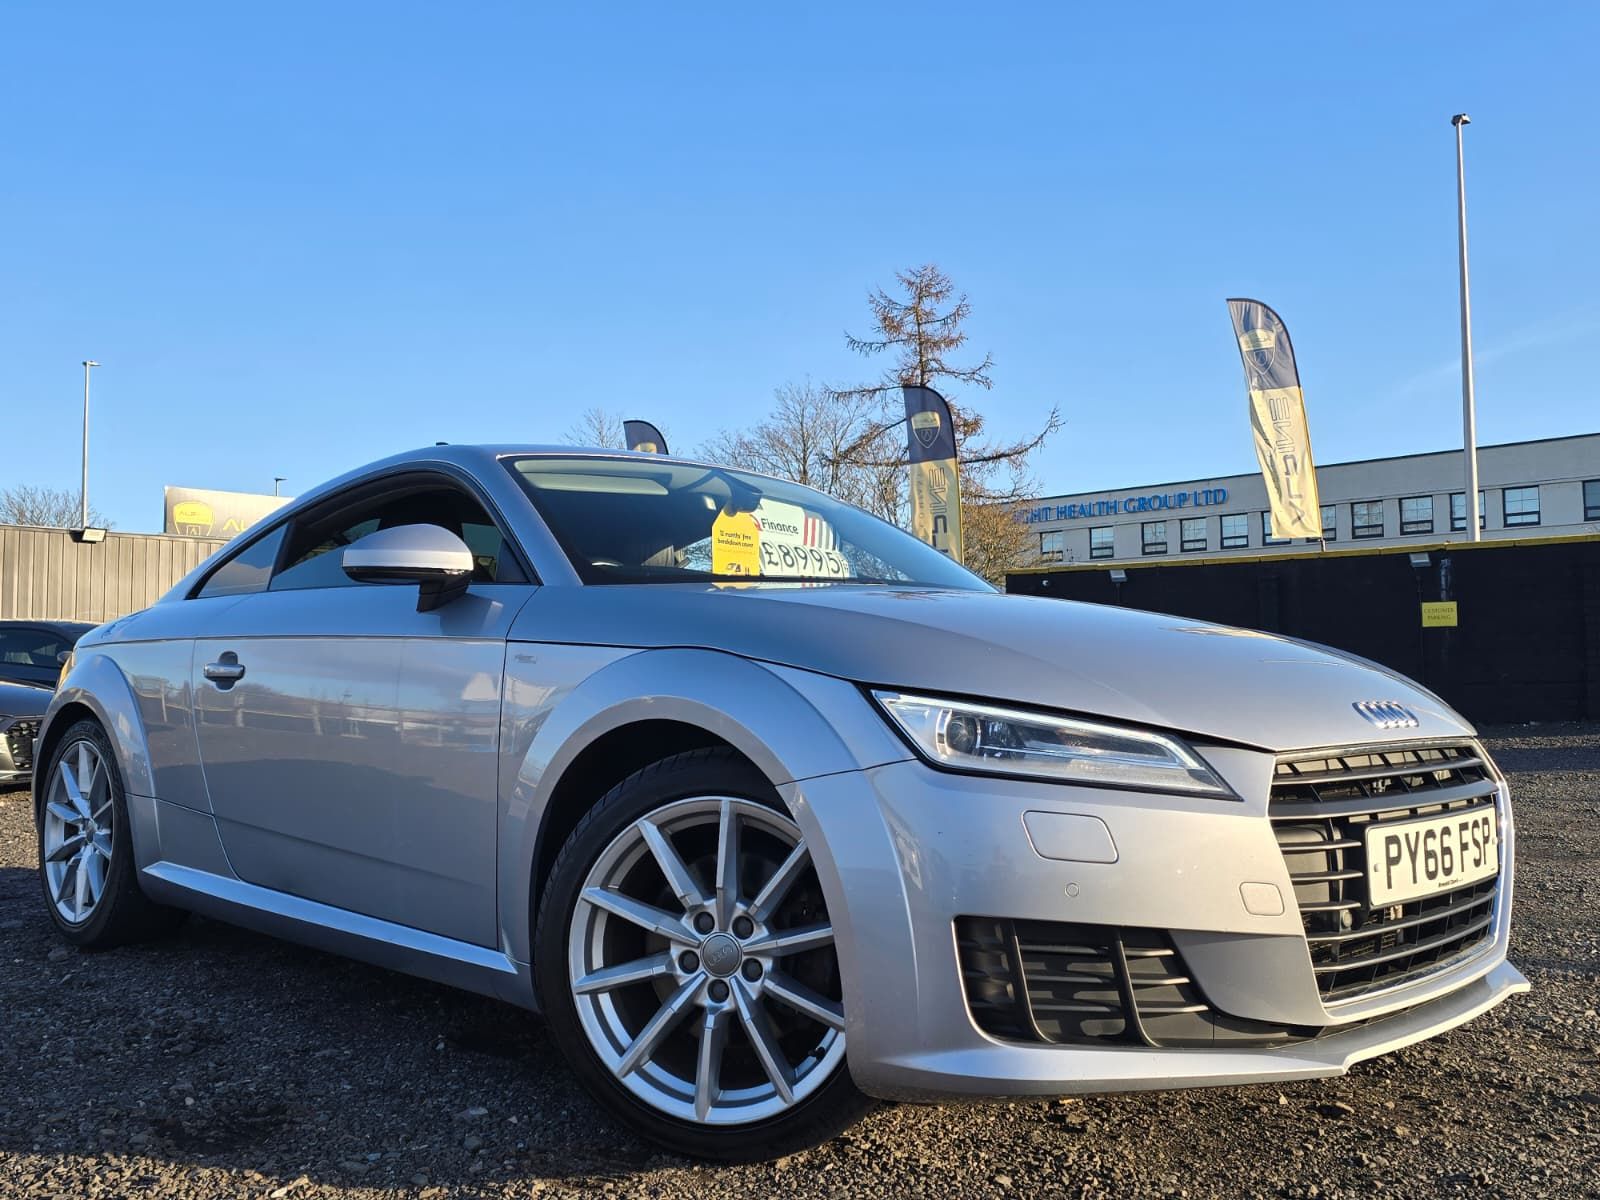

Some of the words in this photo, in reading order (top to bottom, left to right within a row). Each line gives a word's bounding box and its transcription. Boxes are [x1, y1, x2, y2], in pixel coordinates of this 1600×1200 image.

[1056, 498, 1118, 520] HEALTH
[1123, 491, 1188, 513] GROUP
[1193, 488, 1227, 507] LTD
[761, 517, 799, 535] Finance
[761, 541, 840, 574] £8995
[1385, 826, 1453, 889] PY66
[1458, 816, 1490, 872] FSP
